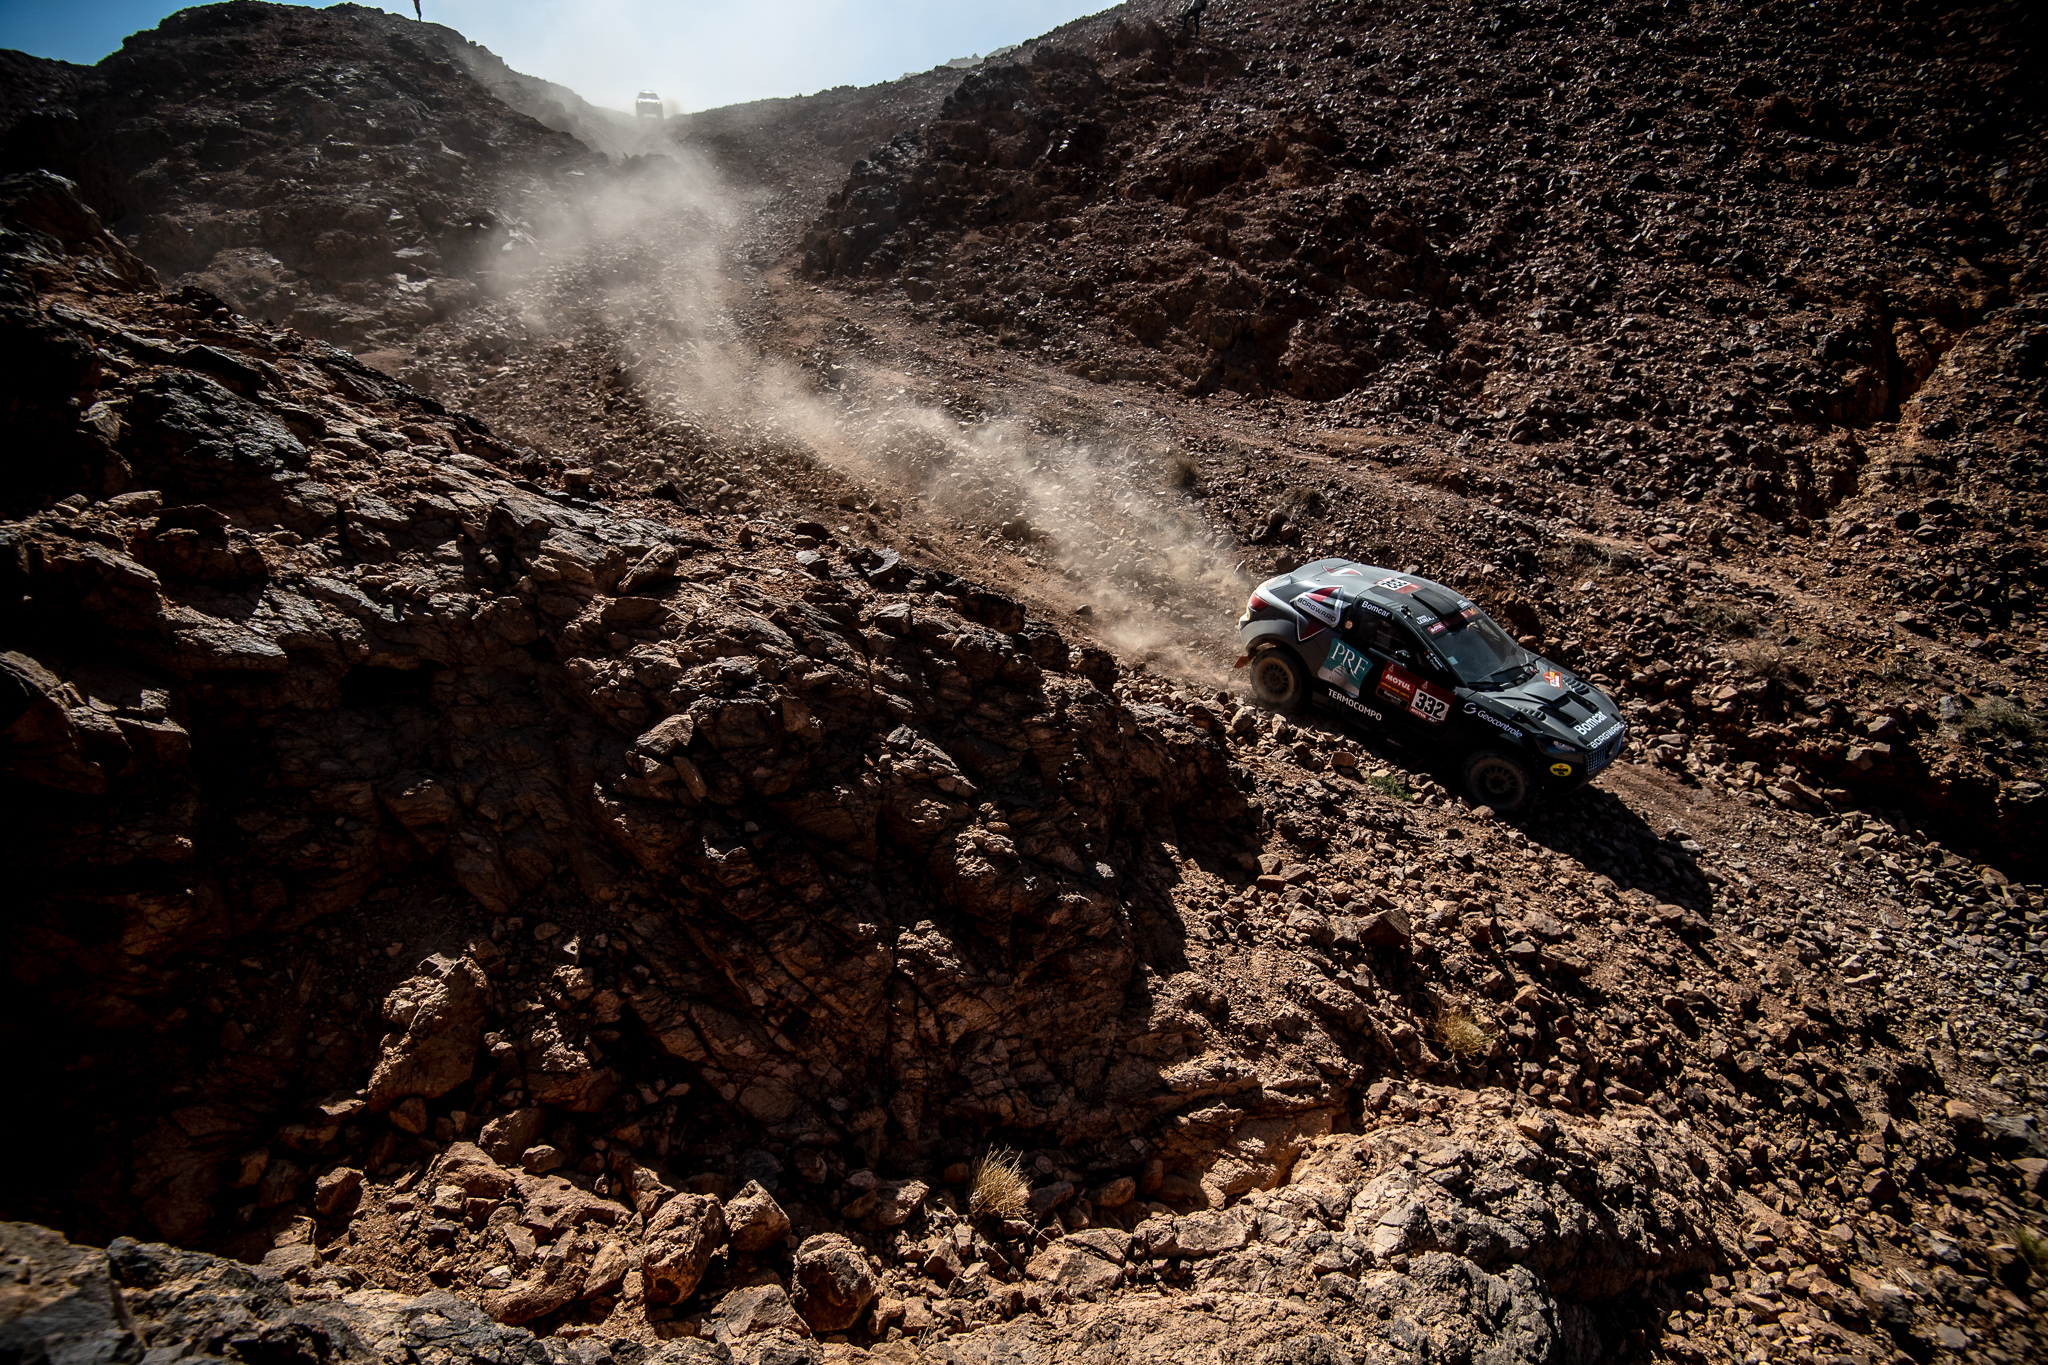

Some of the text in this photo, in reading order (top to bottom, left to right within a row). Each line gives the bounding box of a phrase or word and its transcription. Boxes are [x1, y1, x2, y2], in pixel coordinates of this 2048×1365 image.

[1296, 597, 1337, 622] BORGWARD
[1361, 600, 1391, 617] Bomcar
[1331, 641, 1368, 680] PRF
[1385, 673, 1411, 691] MOTUL
[1328, 688, 1383, 721] TERMOCOMPO
[1410, 707, 1427, 719] MOTUL
[1415, 691, 1446, 719] 332
[1477, 710, 1523, 738] Geocontrole
[1573, 711, 1608, 736] Bomcar
